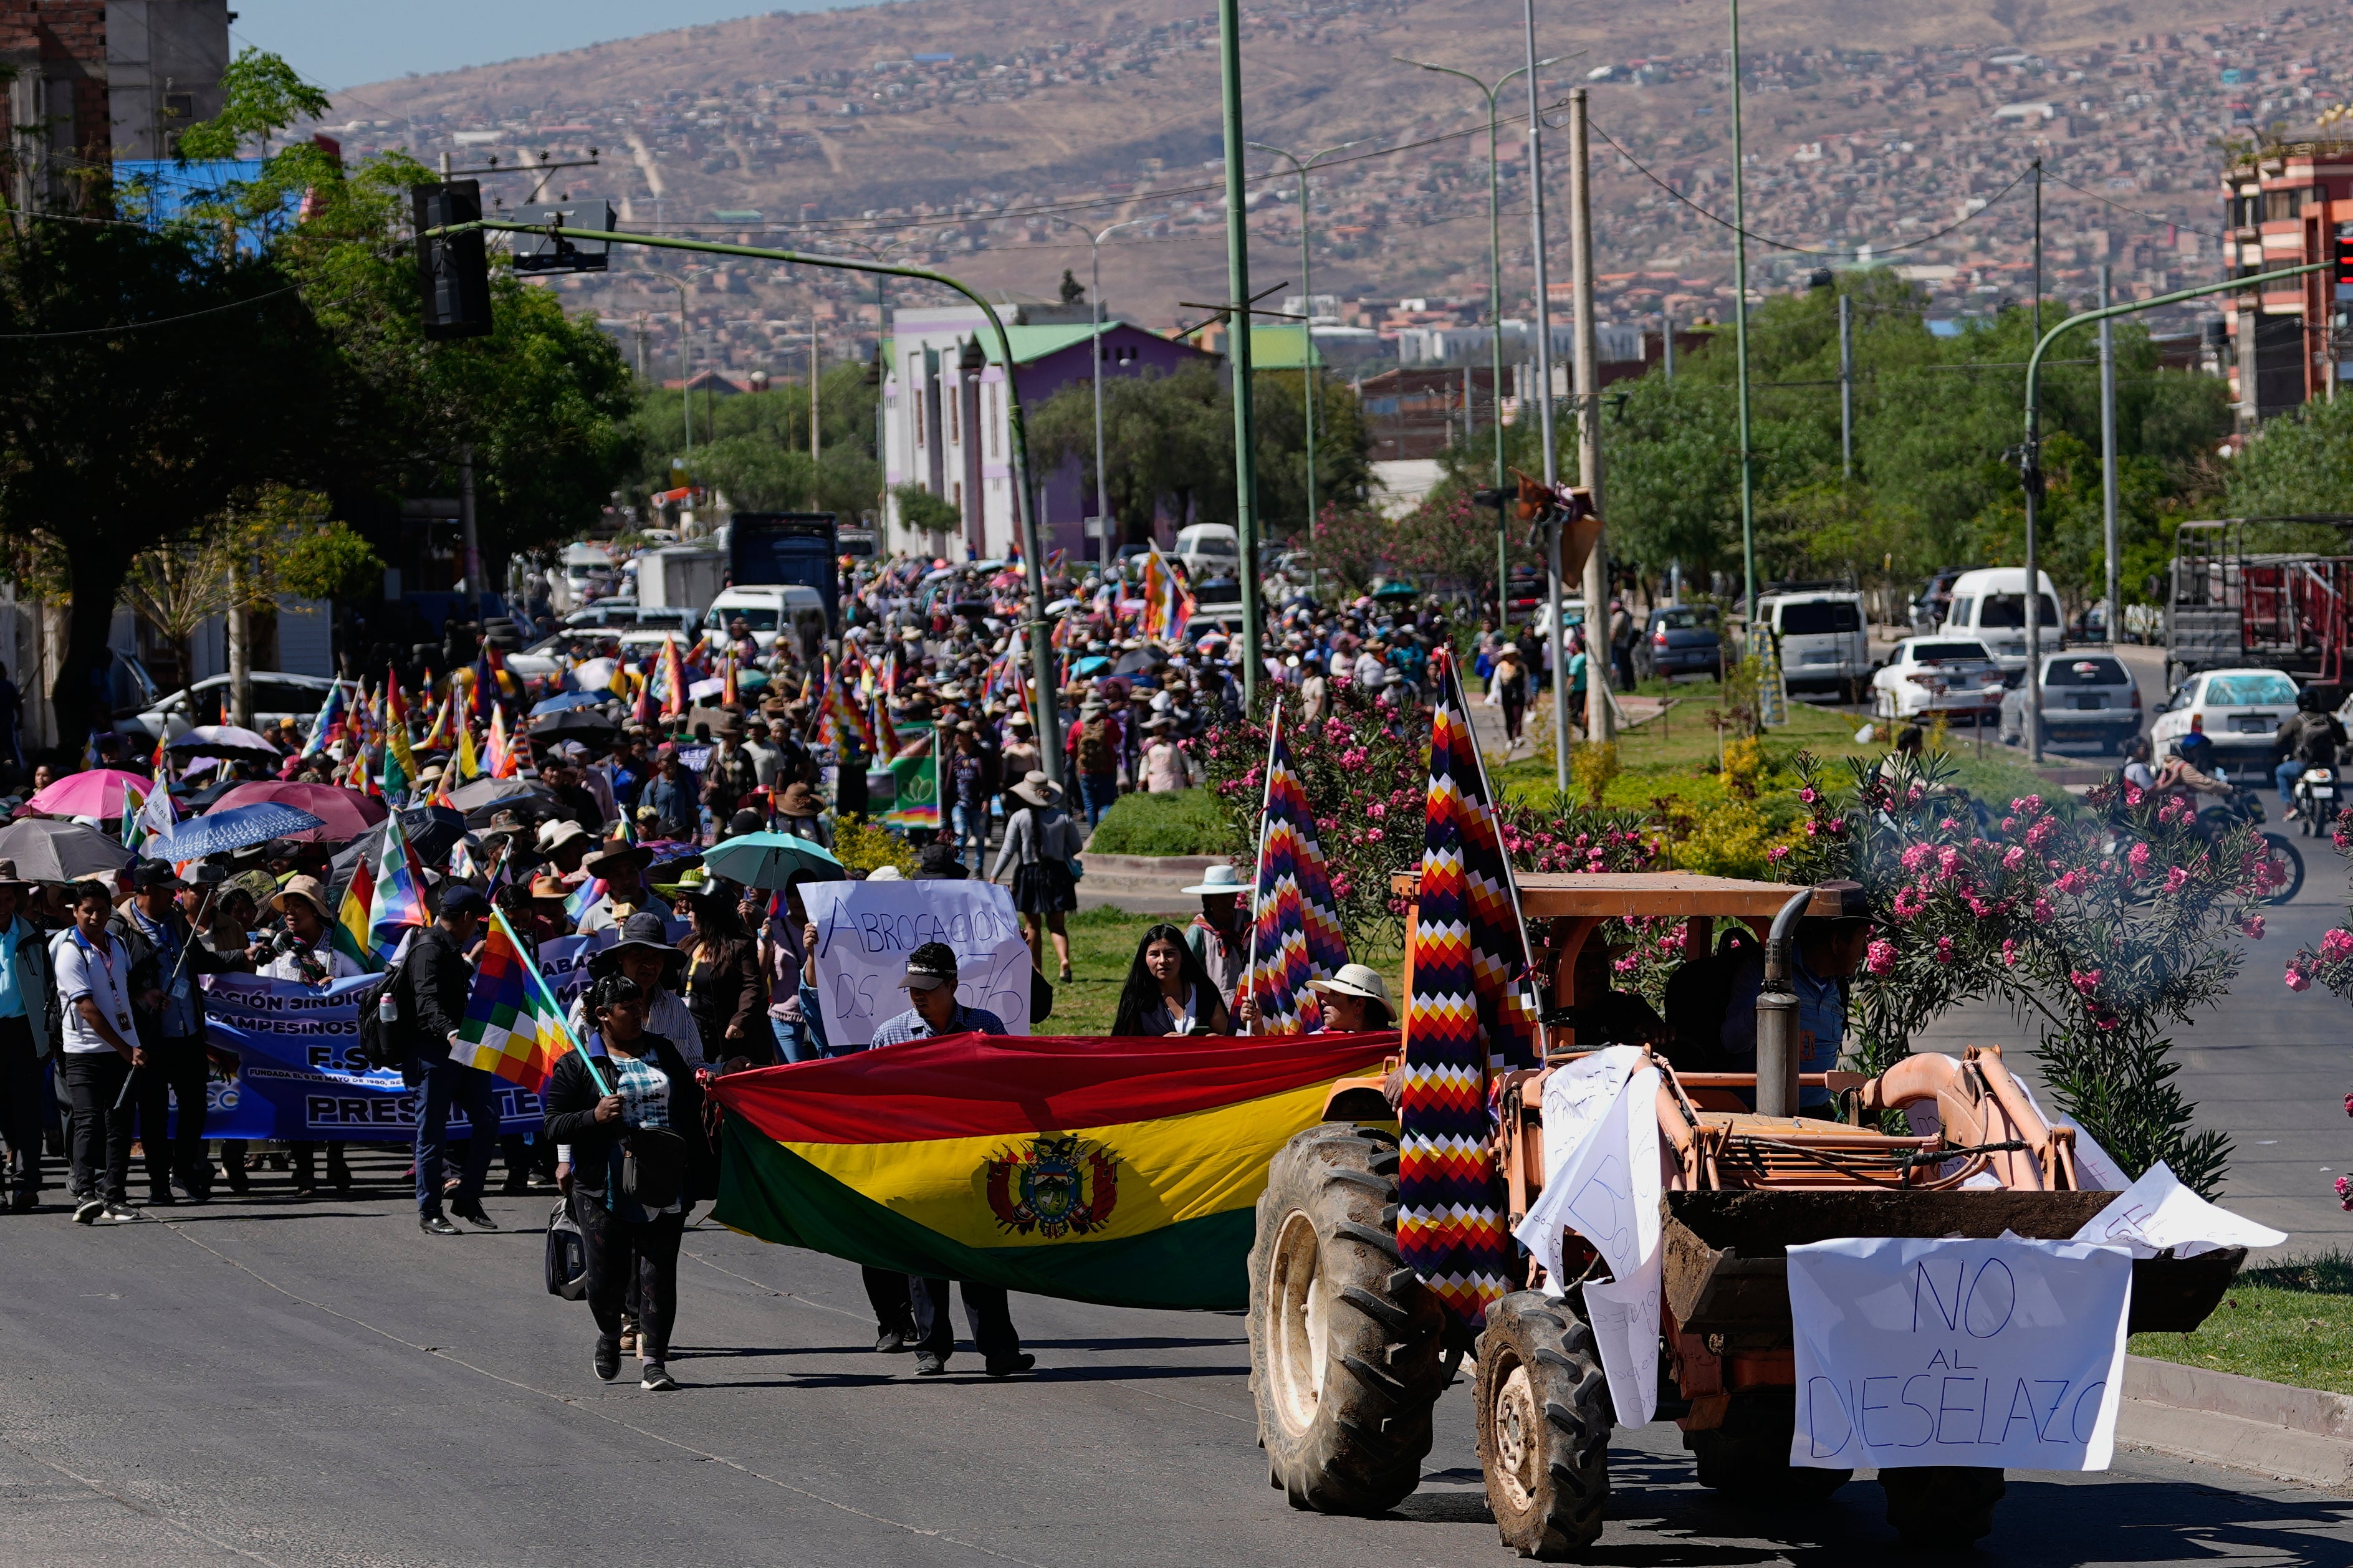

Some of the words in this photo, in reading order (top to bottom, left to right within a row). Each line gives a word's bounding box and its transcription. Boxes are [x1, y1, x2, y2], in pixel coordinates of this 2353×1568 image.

[820, 896, 1014, 958] ABROGACION
[836, 973, 878, 1019] D.S.
[206, 1011, 357, 1035] CAMPESINOS
[249, 1069, 290, 1078] FUNDADA
[308, 1089, 541, 1122] PRESTE
[1913, 1257, 2015, 1339] NO
[1927, 1348, 1978, 1370] AL
[1808, 1374, 2113, 1458] DIESELAZO
